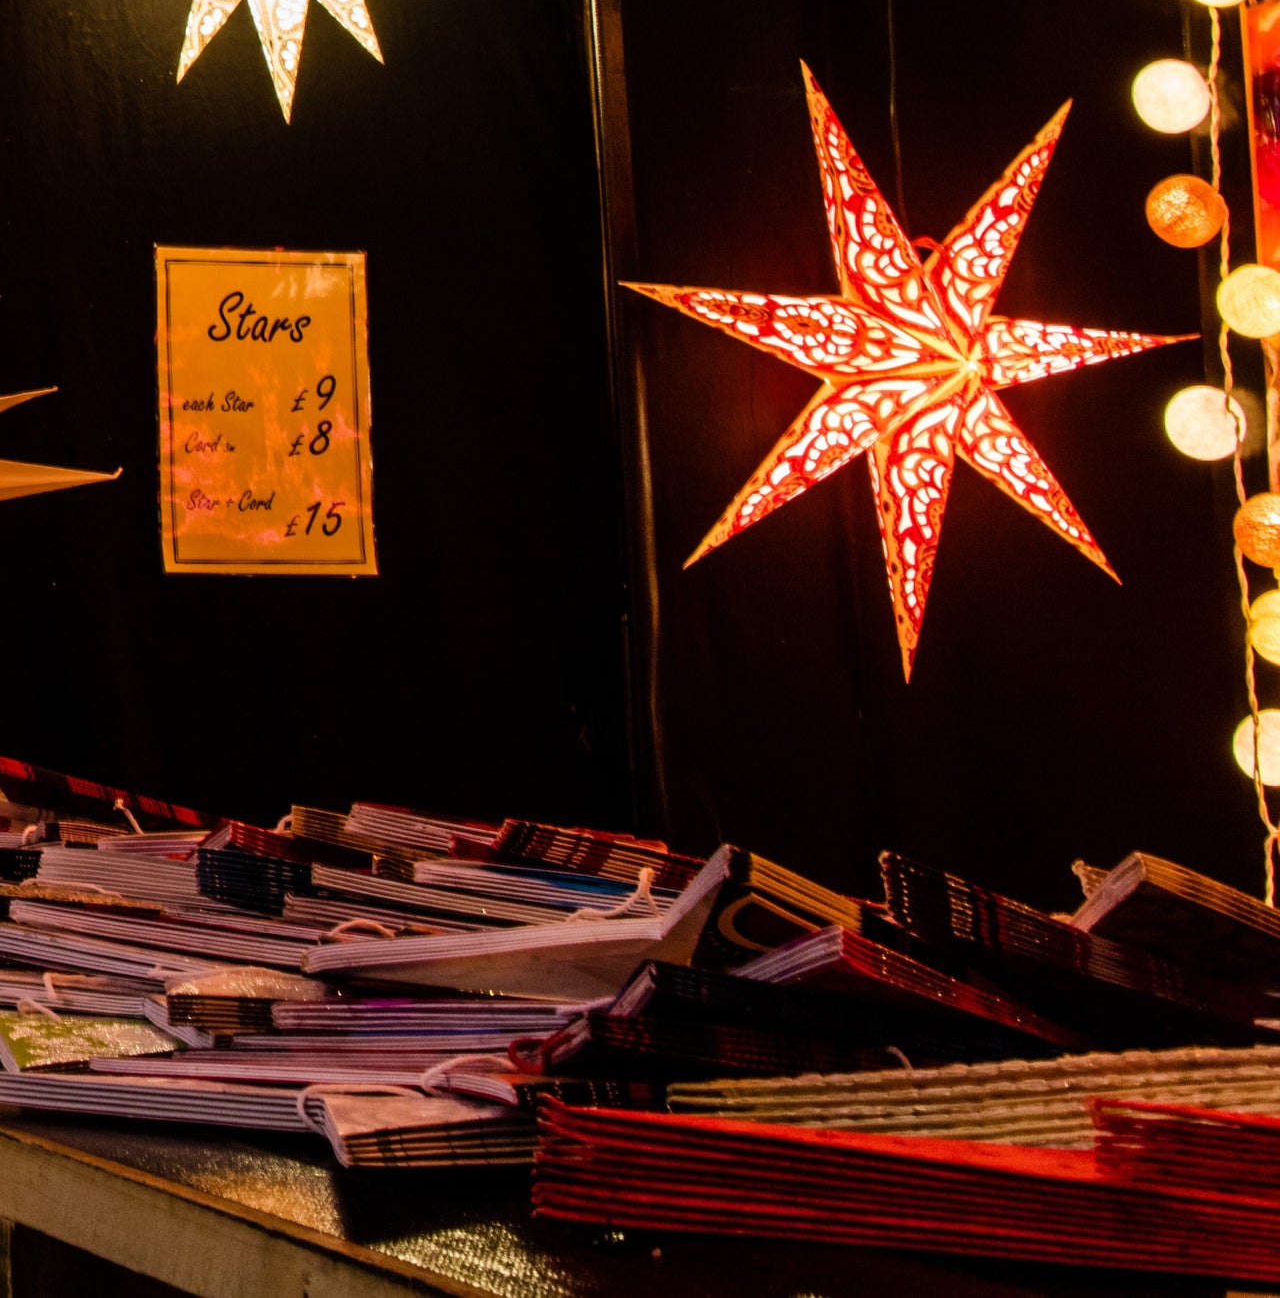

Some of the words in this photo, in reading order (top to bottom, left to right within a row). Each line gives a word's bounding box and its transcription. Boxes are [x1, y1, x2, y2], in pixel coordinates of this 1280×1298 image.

[208, 291, 312, 343] Stars
[182, 392, 215, 412] each
[220, 390, 255, 413] Star
[184, 430, 223, 454] Cord
[186, 488, 220, 511] Star
[238, 488, 276, 512] Cord
